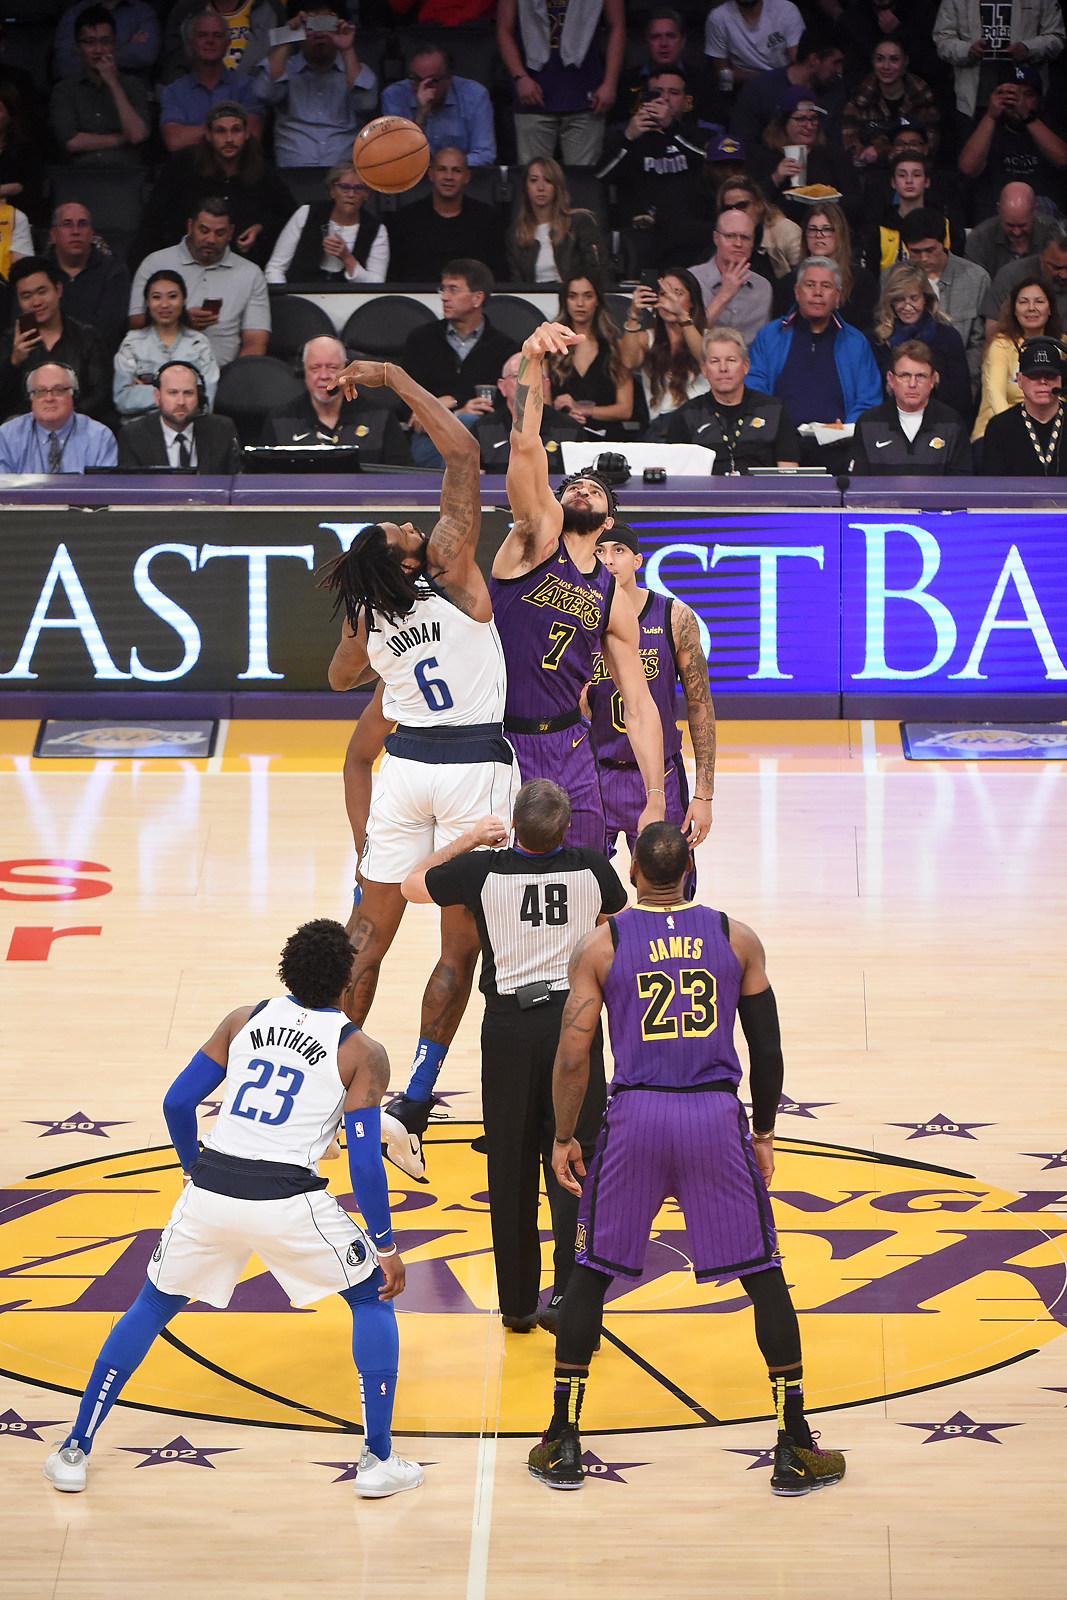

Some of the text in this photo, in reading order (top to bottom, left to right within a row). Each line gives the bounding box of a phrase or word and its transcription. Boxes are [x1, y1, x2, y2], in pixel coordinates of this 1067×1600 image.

[643, 154, 689, 175] PUMA
[0, 543, 314, 681] AST
[848, 523, 1067, 681] BA
[521, 573, 602, 630] LAKERS
[558, 579, 573, 590] LOS
[386, 621, 441, 657] JORDAN
[542, 621, 577, 670] 7
[642, 626, 664, 635] wish
[414, 656, 453, 711] 6
[520, 883, 568, 927] 48
[649, 936, 704, 963] JAMES
[636, 968, 718, 1041] 23
[250, 1026, 328, 1067] MATTHEWS
[230, 1058, 305, 1126] 23
[574, 1223, 587, 1253] LA
